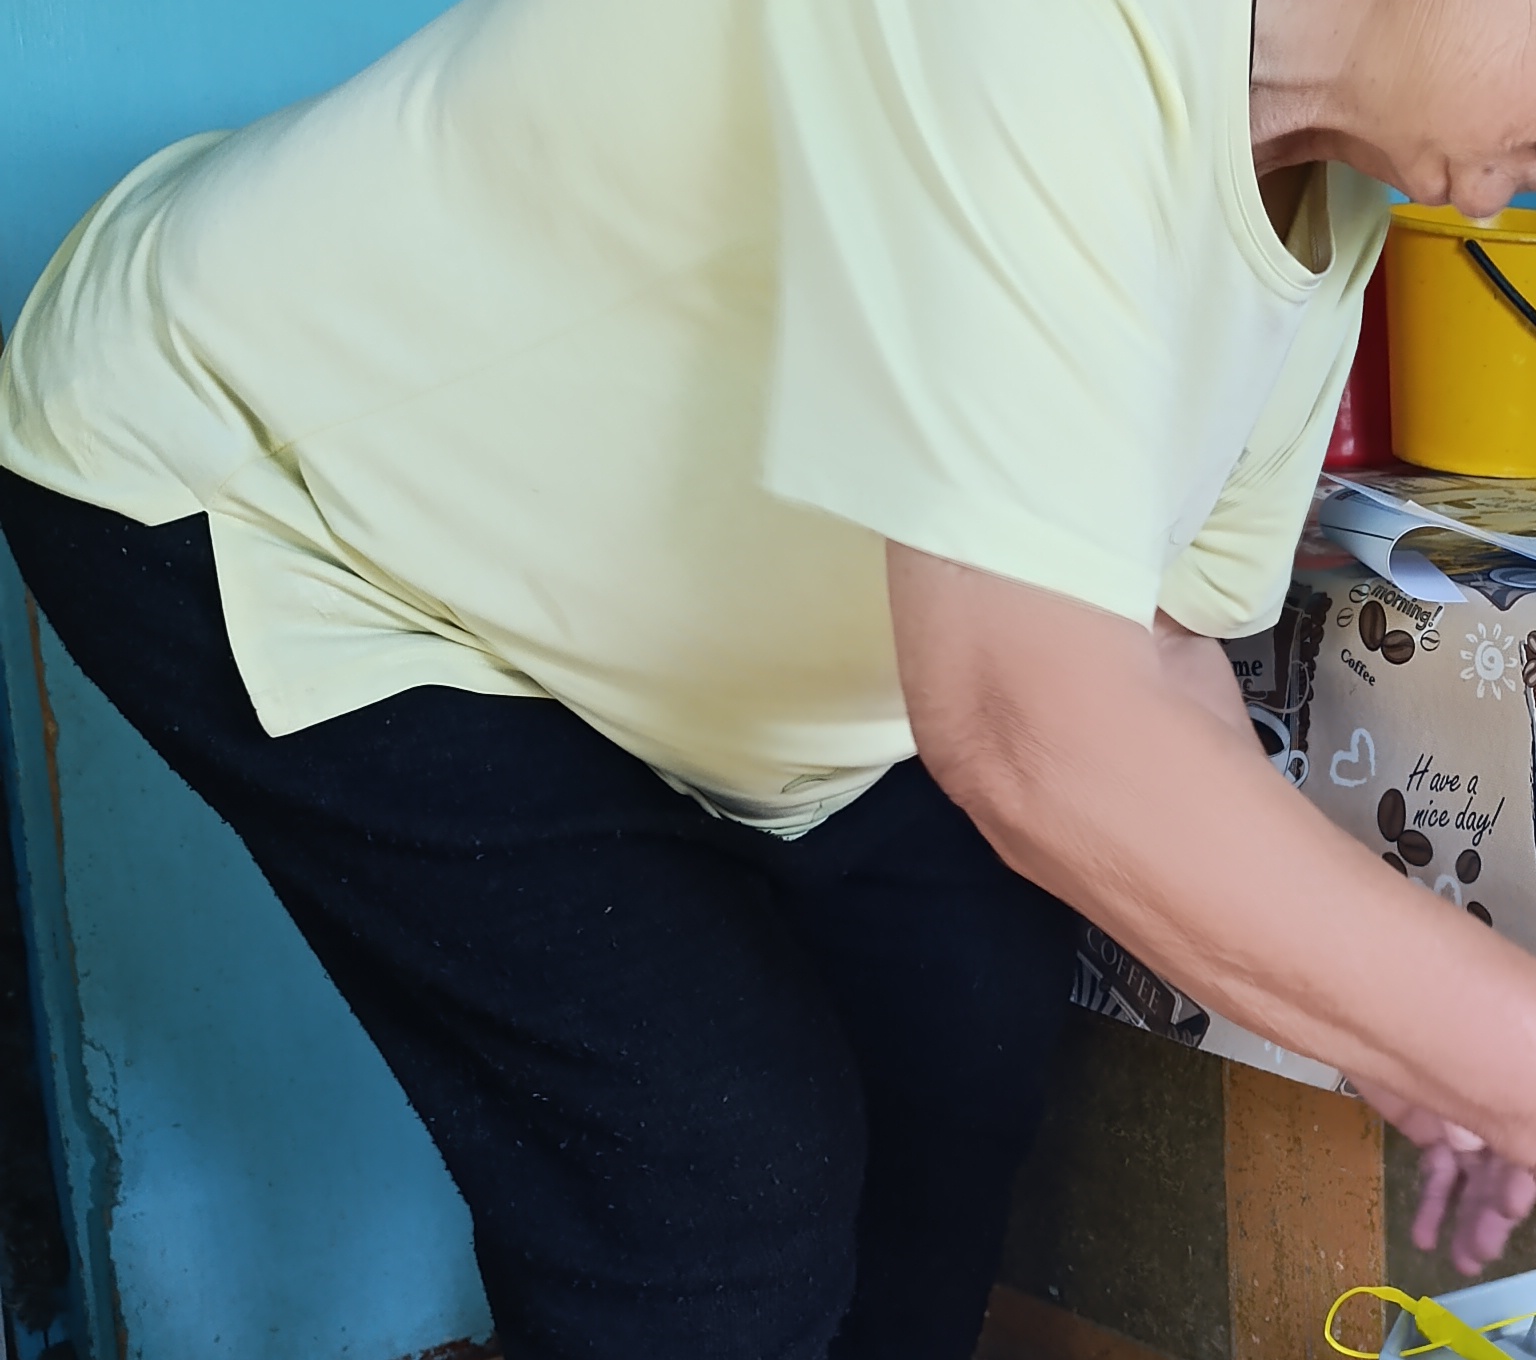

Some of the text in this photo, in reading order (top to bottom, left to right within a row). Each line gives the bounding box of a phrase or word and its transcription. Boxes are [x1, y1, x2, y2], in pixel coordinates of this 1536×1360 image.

[1371, 581, 1444, 631] morning!
[1232, 658, 1263, 677] me
[1340, 648, 1376, 686] Coffee
[1406, 753, 1478, 795] Have a
[1413, 796, 1505, 847] nice day!
[1086, 926, 1161, 1015] COFFEE
